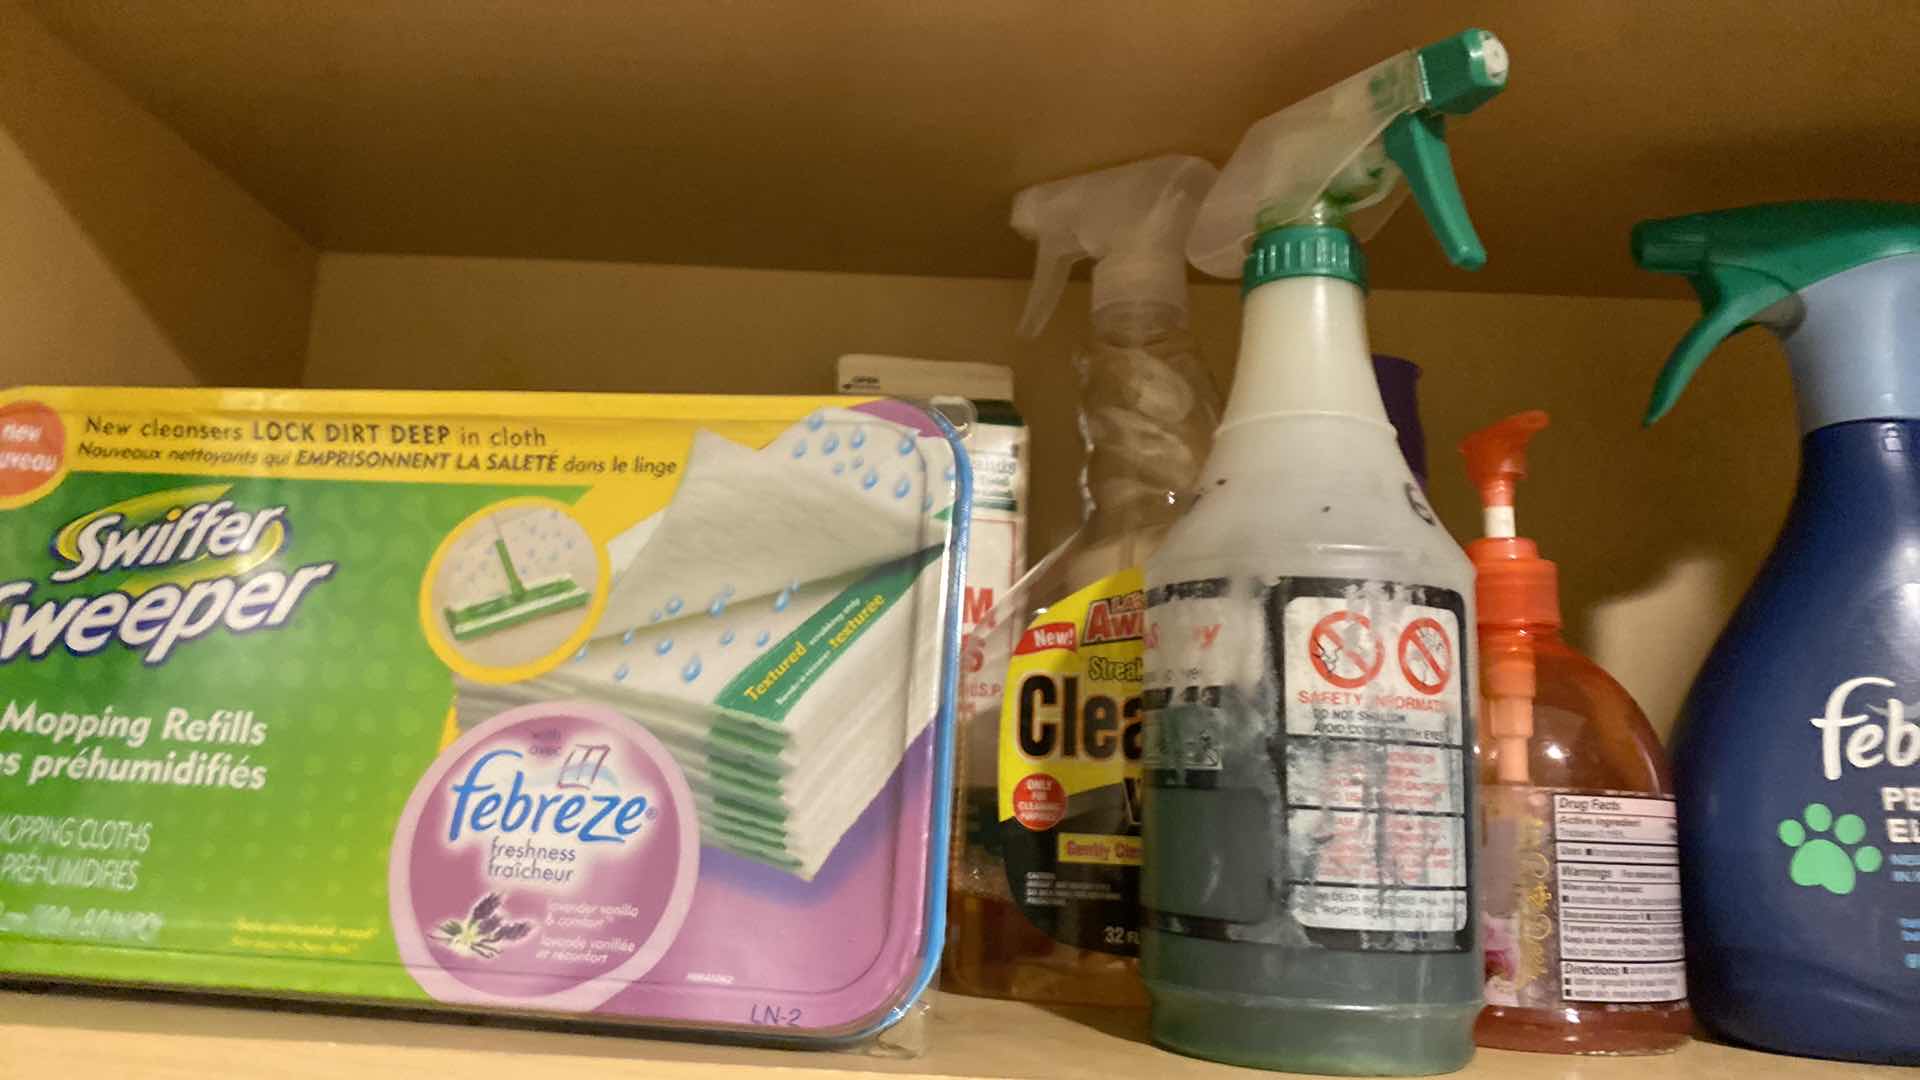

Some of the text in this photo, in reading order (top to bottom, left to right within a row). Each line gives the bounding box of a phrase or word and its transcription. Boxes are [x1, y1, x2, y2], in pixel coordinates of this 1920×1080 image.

[84, 415, 547, 448] New cleansers LOCK DIRT DEEP in cloth
[77, 441, 677, 478] Nouveaux nettoyants qui EMPRISONNENT LA SALETÉ dans le linge
[50, 500, 289, 583] Swiffer
[1033, 628, 1075, 648] New!
[743, 639, 807, 702] Textured
[1297, 690, 1361, 706] SAFETY
[0, 699, 268, 748] Mopping Refills
[1312, 708, 1329, 720] DO
[1332, 709, 1353, 721] NOT
[27, 746, 268, 790] préhumidifiés
[1559, 798, 1621, 812] Drug Facts
[1559, 816, 1594, 826] Active
[77, 818, 153, 852] CLOTHS
[489, 836, 577, 862] freshness
[487, 858, 576, 883] fraîcheur
[1103, 926, 1125, 944] 32
[1564, 963, 1620, 977] Directions
[751, 1003, 802, 1027] LN-2
